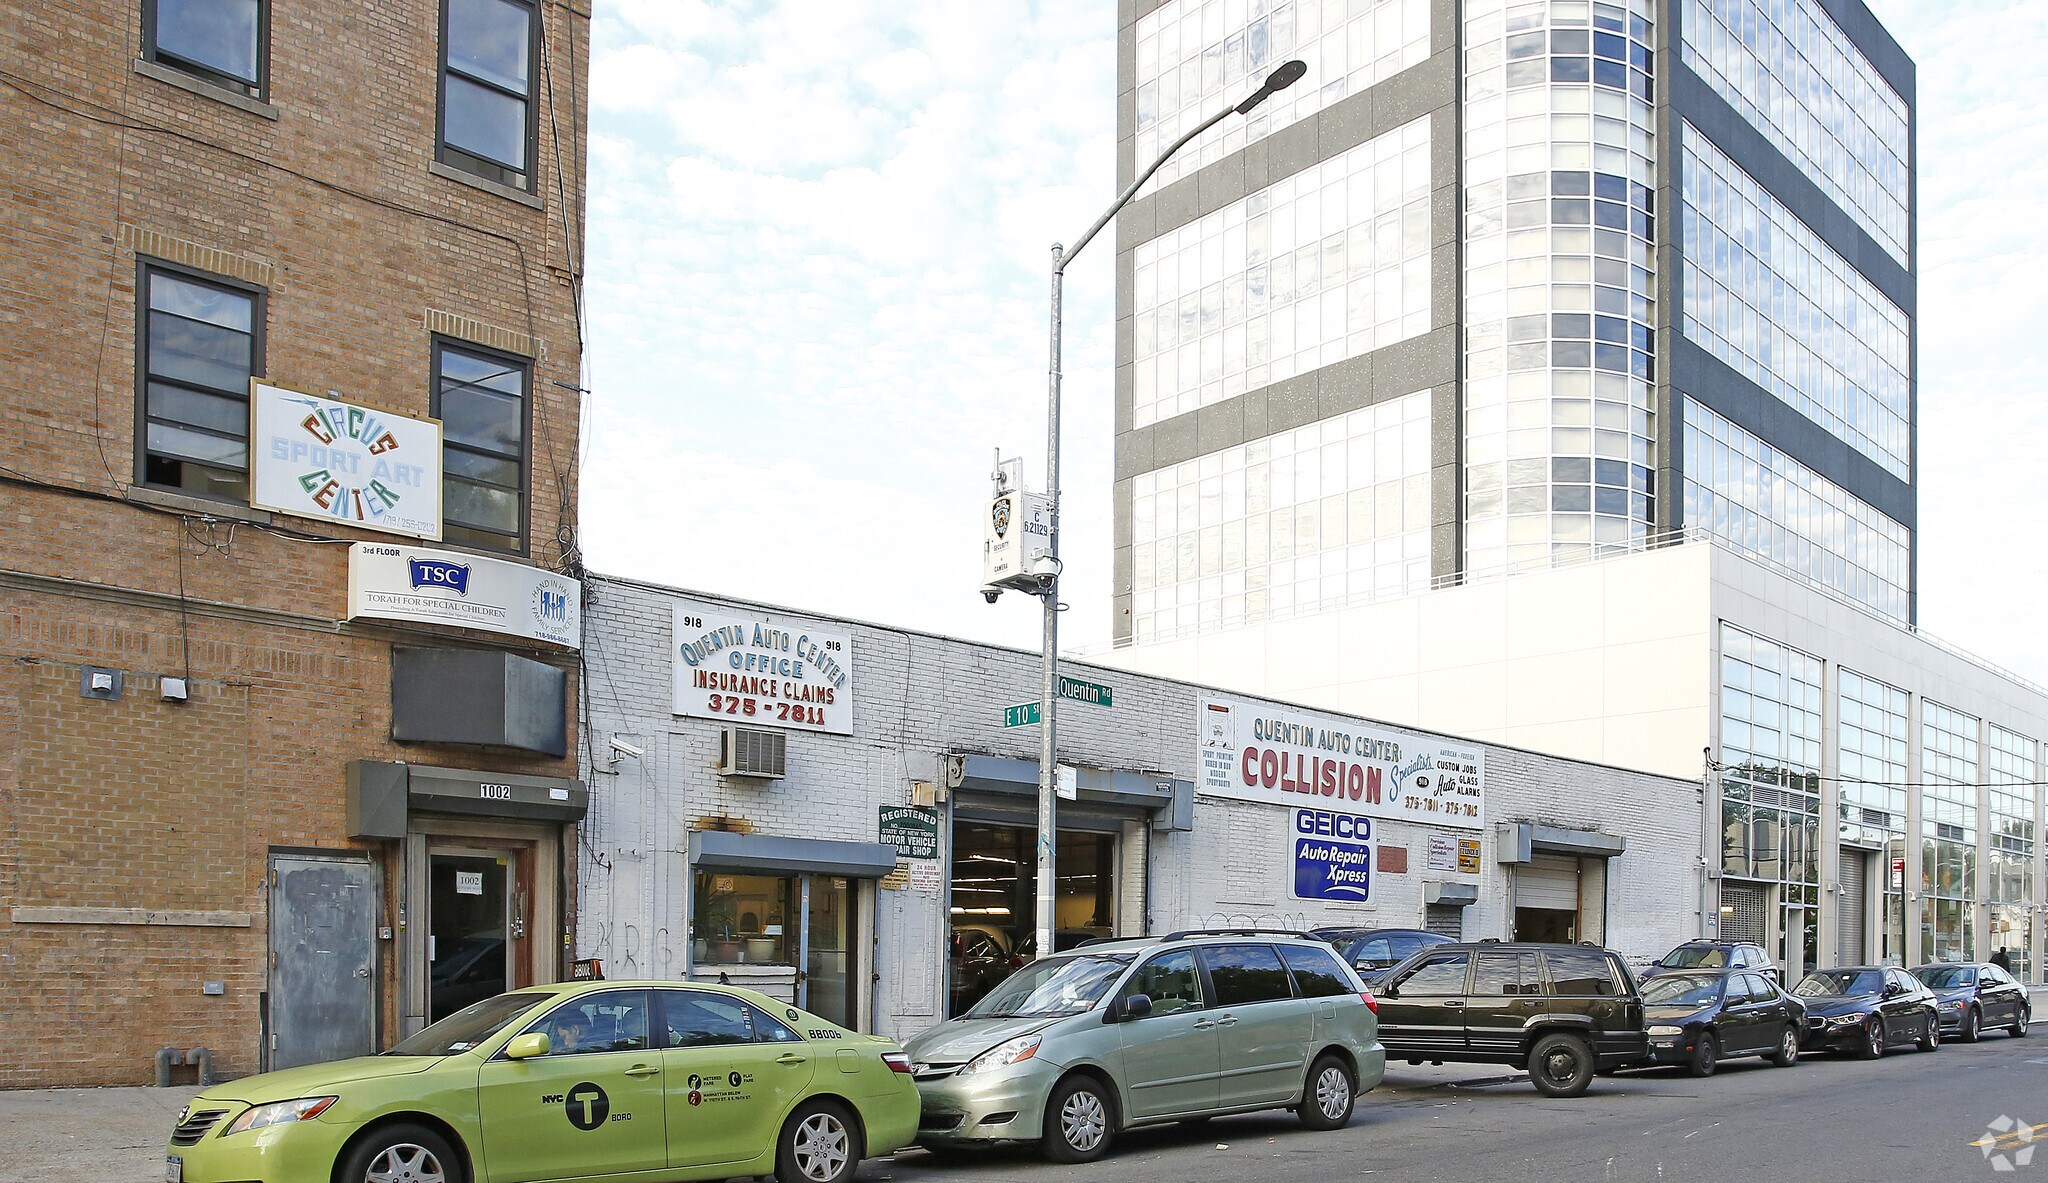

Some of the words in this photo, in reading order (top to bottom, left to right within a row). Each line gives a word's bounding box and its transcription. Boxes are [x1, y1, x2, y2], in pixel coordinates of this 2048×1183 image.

[300, 406, 399, 455] CIRCUS
[271, 436, 361, 474] SPORT
[370, 458, 423, 488] ART
[298, 470, 400, 520] CENTER
[1035, 513, 1039, 522] C
[376, 548, 400, 557] FLOOR
[993, 541, 1009, 552] SECURITY
[420, 566, 459, 584] TSC
[994, 563, 1008, 572] CAMERA
[532, 580, 550, 598] HAND
[558, 584, 573, 607] HAND
[367, 594, 400, 604] TORAH
[403, 598, 422, 606] FOR
[423, 599, 460, 611] SPECIAL
[462, 604, 505, 618] CHILDREN
[532, 607, 549, 630] FAMILY
[551, 616, 573, 634] SERVICES
[684, 616, 702, 628] 918
[826, 640, 841, 651] 918
[680, 625, 744, 666] QUENTIN
[751, 623, 790, 652] AUTO
[797, 635, 847, 690] CENTER
[729, 651, 803, 678] OFFICE
[694, 669, 777, 697] INSURANCE
[784, 682, 834, 705] CLAIMS
[1060, 679, 1098, 702] Quentin
[1102, 688, 1111, 698] Rd
[1007, 709, 1011, 726] E
[1017, 706, 1028, 724] 10
[1033, 704, 1040, 714] St
[1255, 717, 1314, 747] QUENTIN
[1317, 729, 1350, 751] AUTO
[1355, 736, 1401, 762] CENTER
[1242, 746, 1382, 804] COLLISION
[1389, 753, 1434, 802] Specialists
[1437, 760, 1459, 772] CUSTOM
[1462, 764, 1477, 774] JOBS
[482, 785, 509, 798] 1002
[1434, 774, 1456, 796] Auto
[1459, 775, 1478, 786] GLASS
[1457, 788, 1480, 797] ALARMS
[881, 808, 936, 825] REGISTERED
[1405, 796, 1439, 811] 375-7811
[1445, 801, 1478, 817] 375-7812
[1297, 810, 1370, 840] GEICO
[880, 834, 905, 845] MOTOR
[908, 837, 936, 847] VEHICLE
[896, 845, 910, 855] PAIR
[913, 846, 931, 856] SHOP
[1299, 843, 1328, 860] Auto
[1329, 846, 1367, 867] Repair
[460, 876, 479, 885] 1002
[1326, 864, 1366, 885] Xpress
[542, 1095, 564, 1103] NYC
[575, 1092, 598, 1124] T
